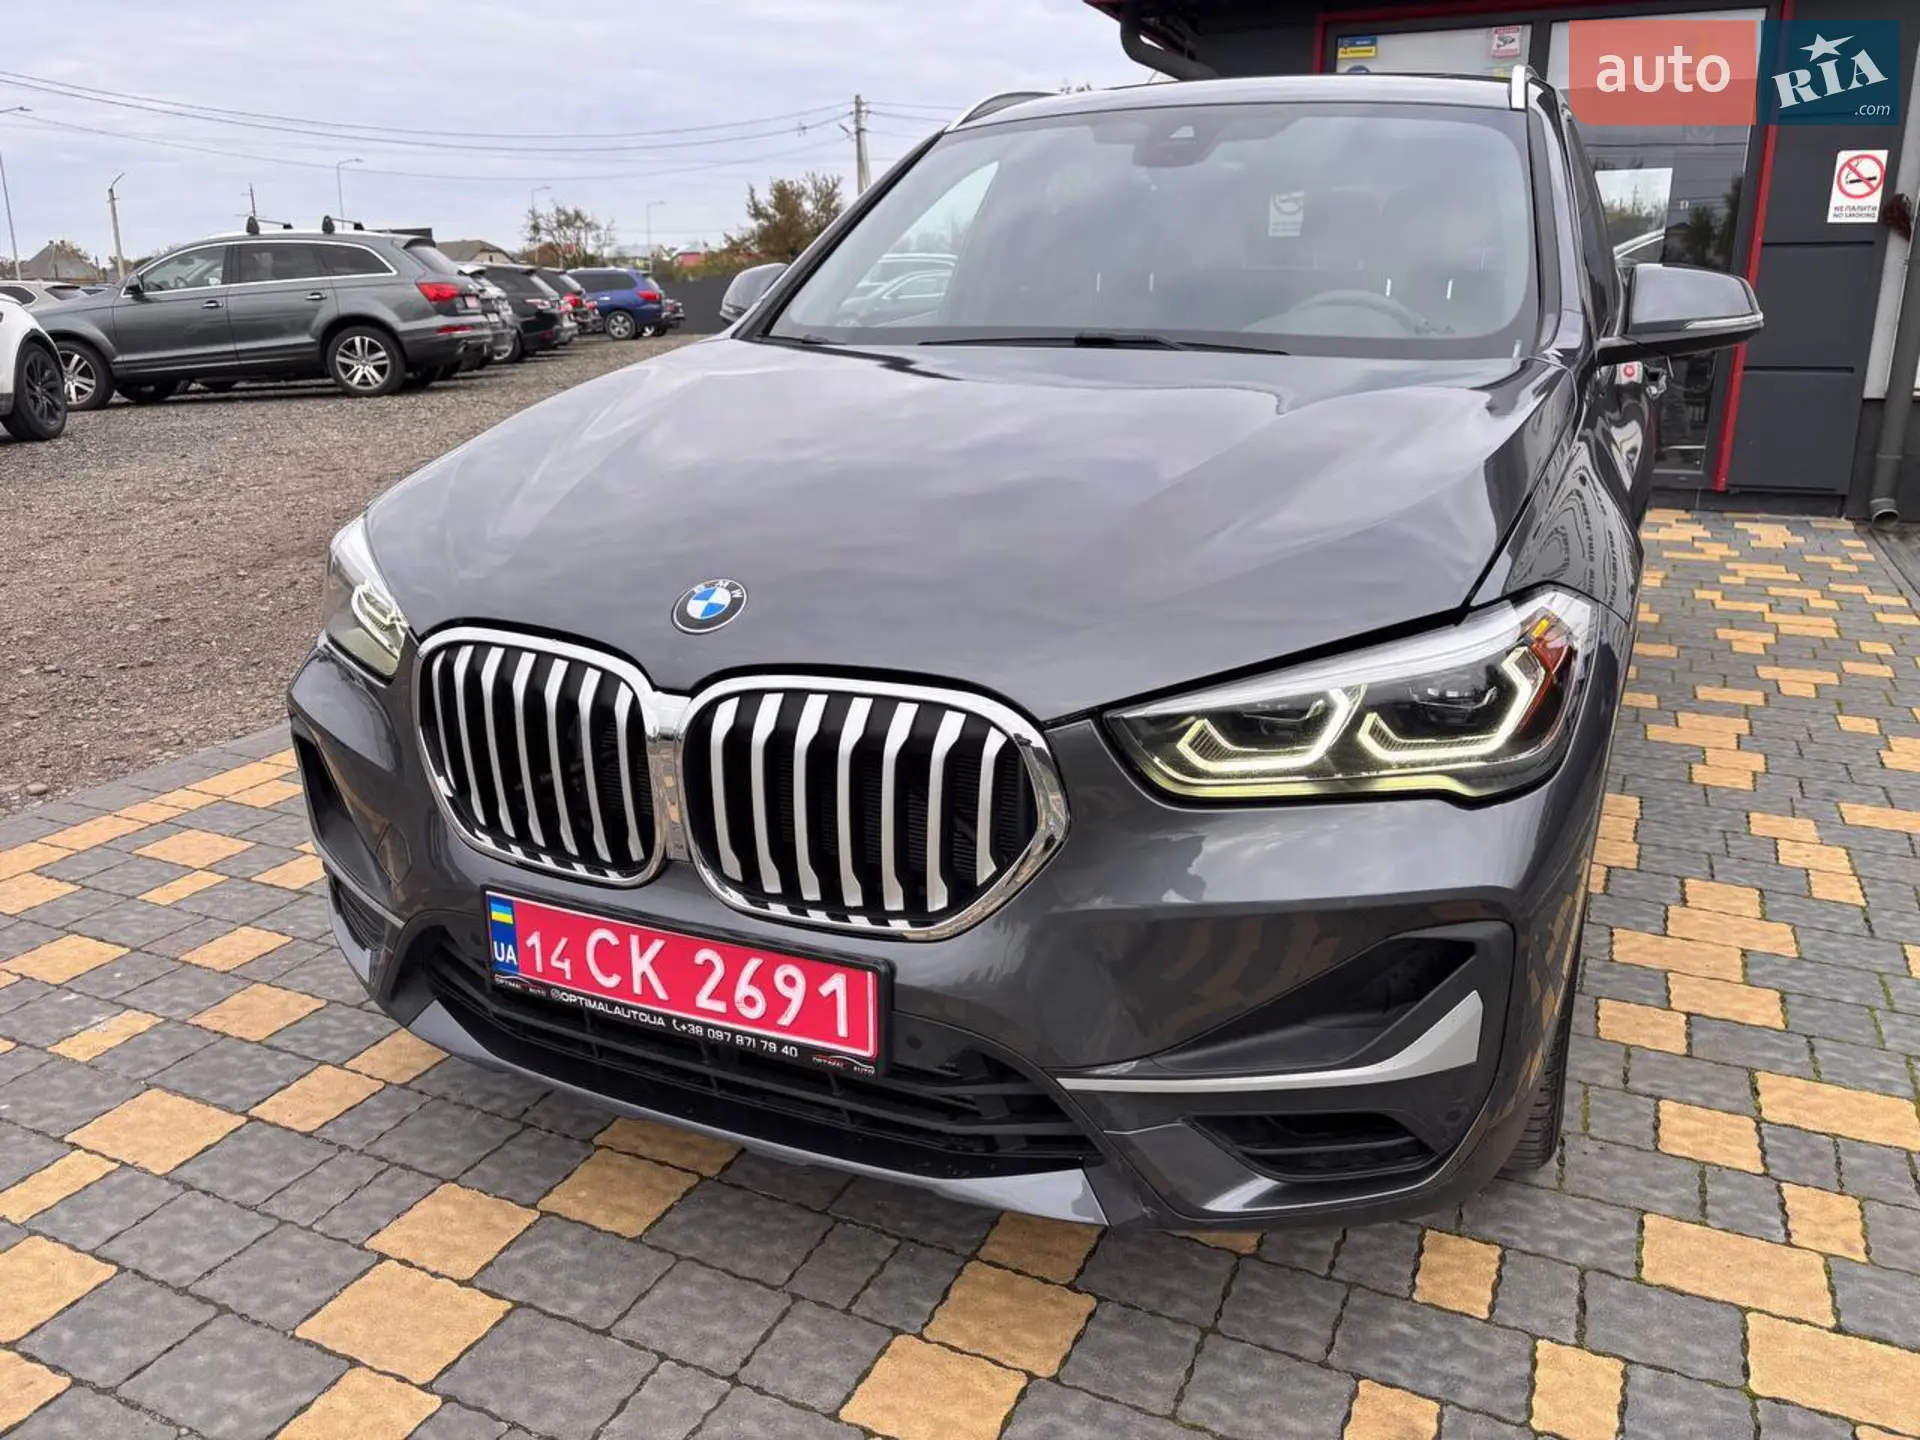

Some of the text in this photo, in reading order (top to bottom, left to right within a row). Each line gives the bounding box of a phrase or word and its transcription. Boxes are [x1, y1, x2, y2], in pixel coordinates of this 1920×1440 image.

[493, 941, 518, 966] UA
[525, 927, 849, 1038] 14 CK 2691
[707, 1029, 732, 1043] 097
[735, 1035, 757, 1048] 871
[781, 1045, 799, 1058] 40
